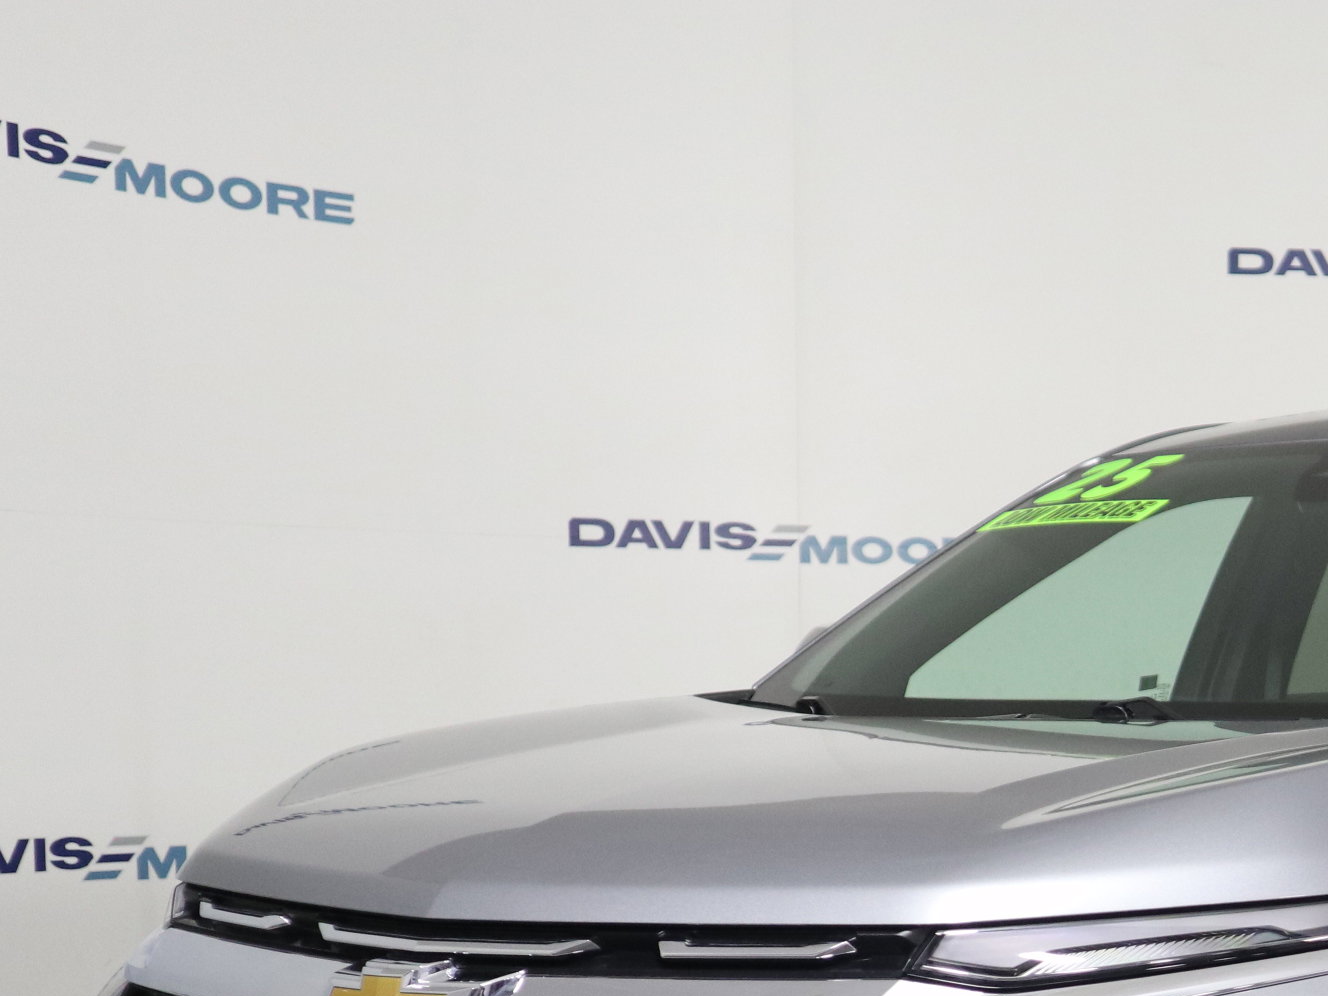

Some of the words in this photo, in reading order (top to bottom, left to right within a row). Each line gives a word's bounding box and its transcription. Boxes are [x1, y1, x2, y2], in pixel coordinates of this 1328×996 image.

[0, 119, 69, 165] IS
[114, 157, 355, 226] MOORE
[1032, 453, 1185, 504] 25
[1042, 500, 1158, 521] MILEAGE
[568, 517, 757, 551] DAVIS
[800, 534, 953, 566] MOO
